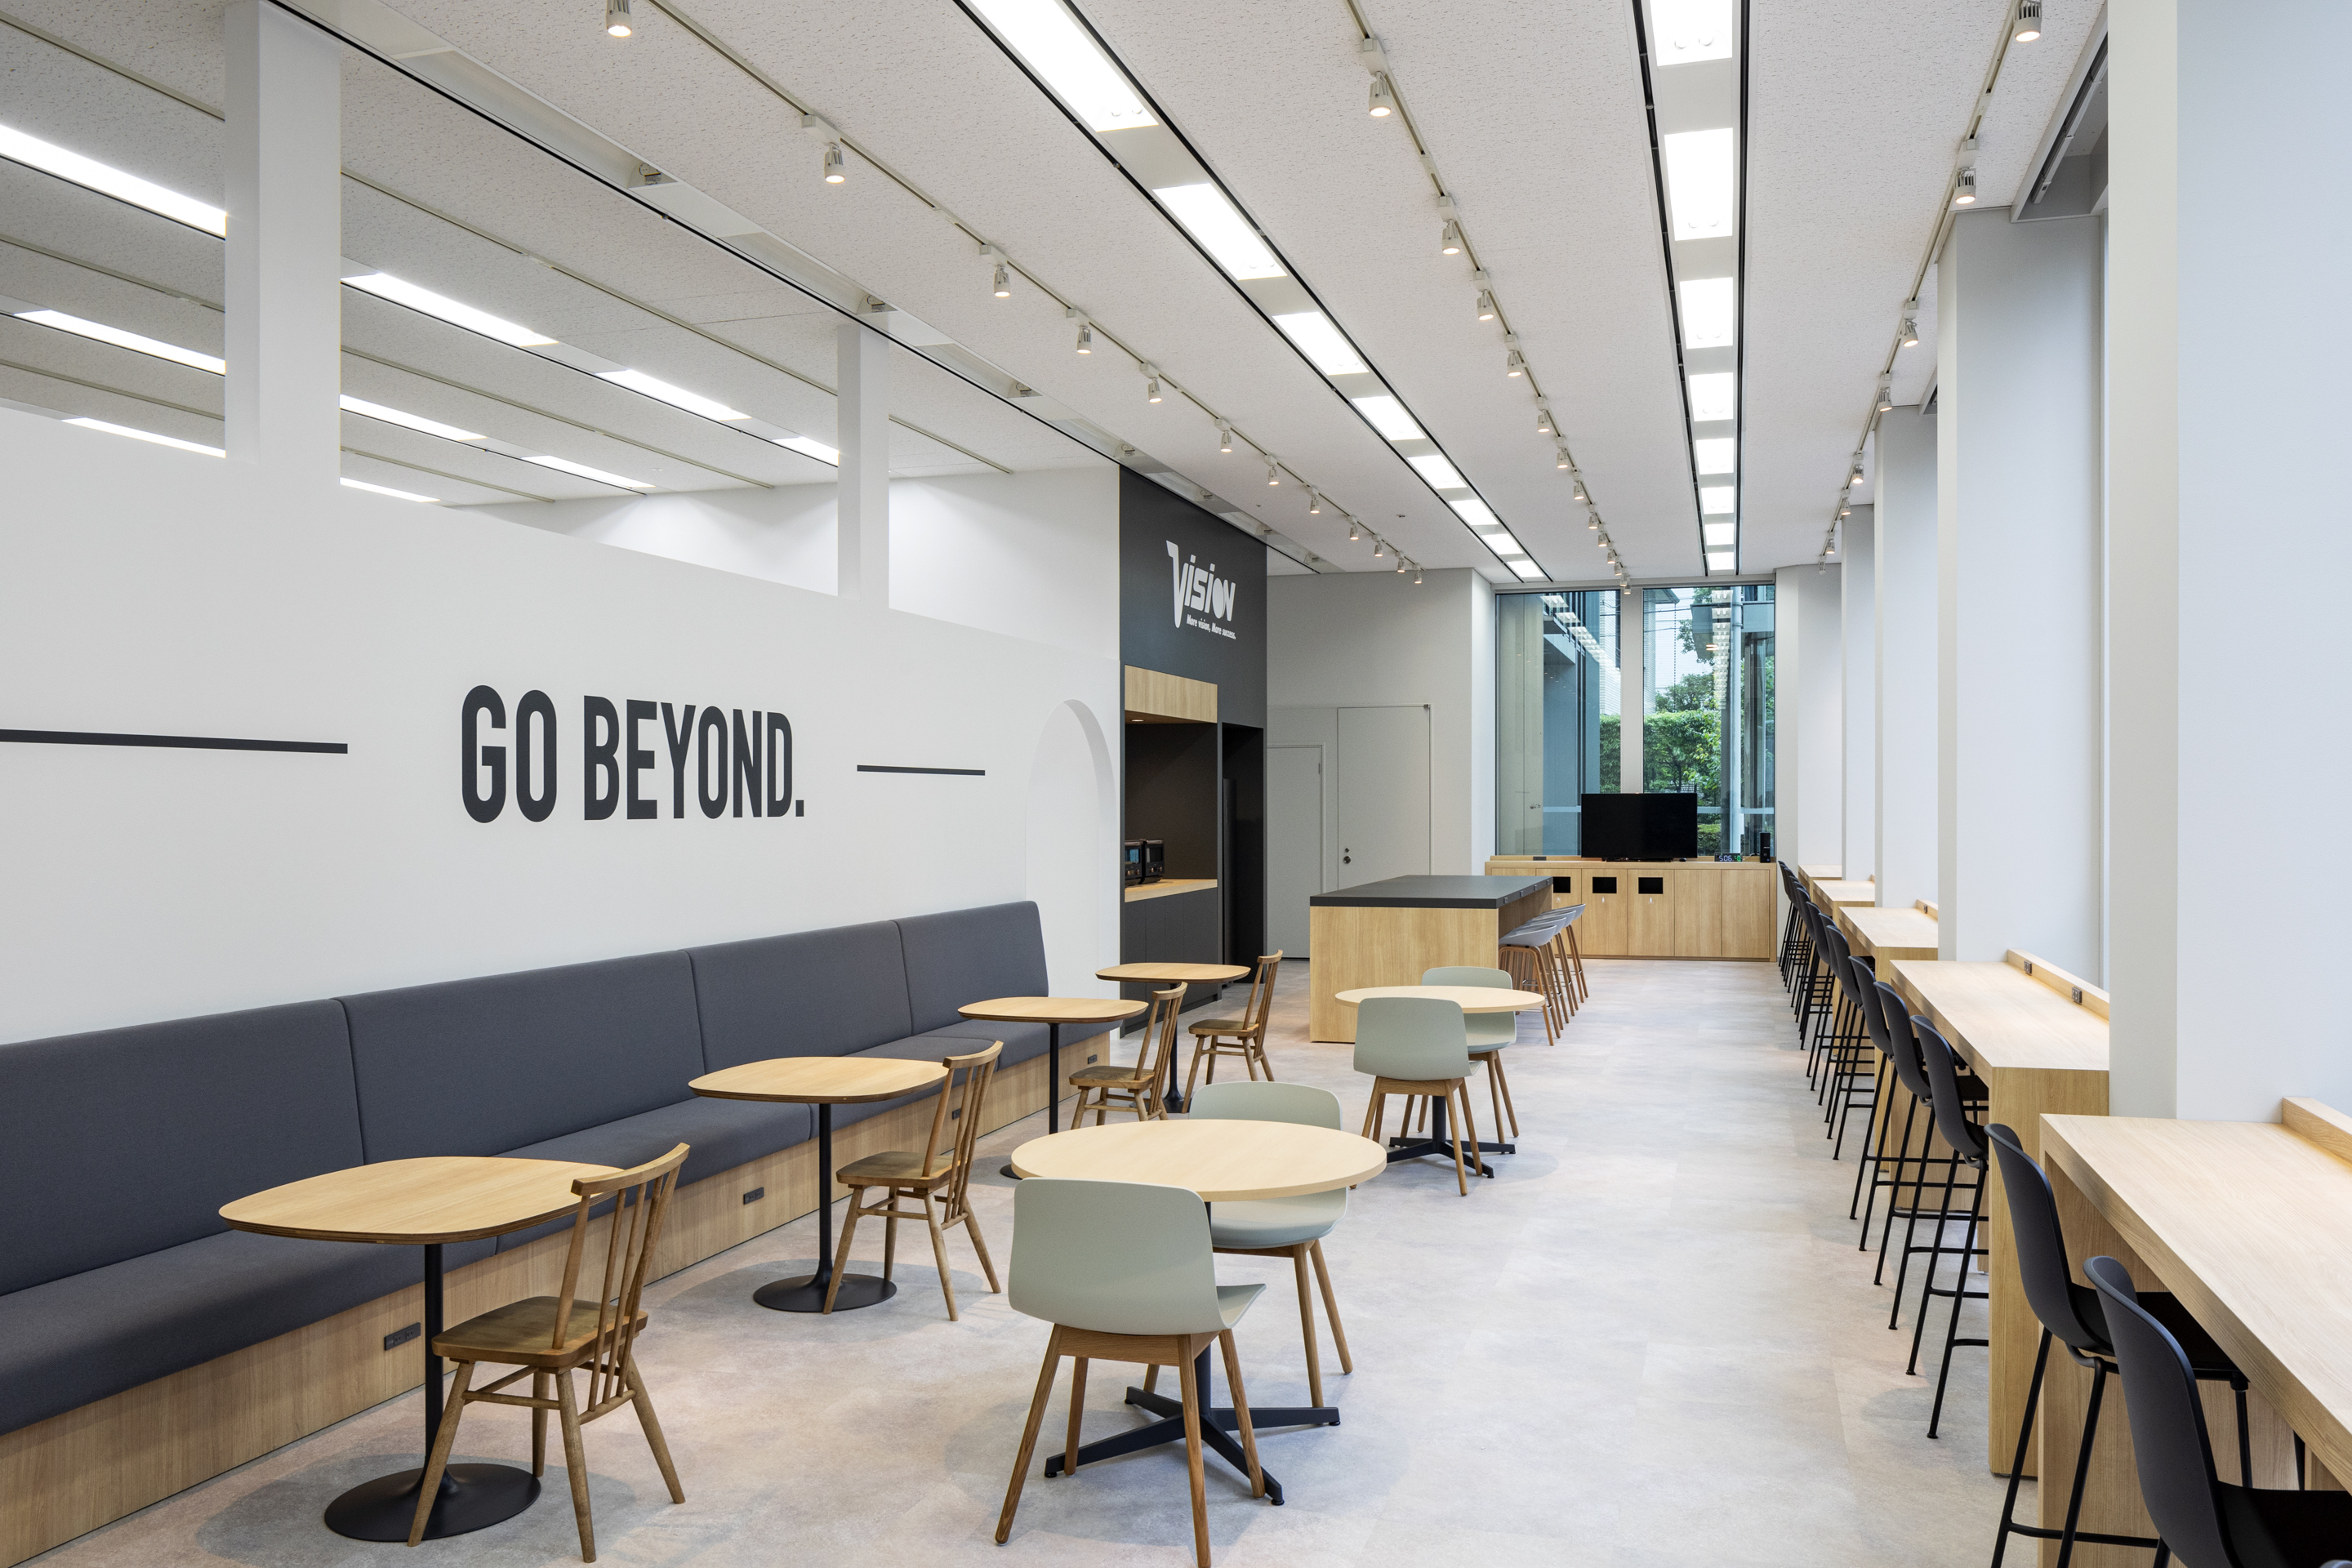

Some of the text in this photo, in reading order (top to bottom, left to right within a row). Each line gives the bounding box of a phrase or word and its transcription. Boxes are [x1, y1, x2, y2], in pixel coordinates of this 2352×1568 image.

[1187, 614, 1197, 627] More
[1211, 622, 1222, 635] More
[461, 684, 804, 823] GO BEYOND.
